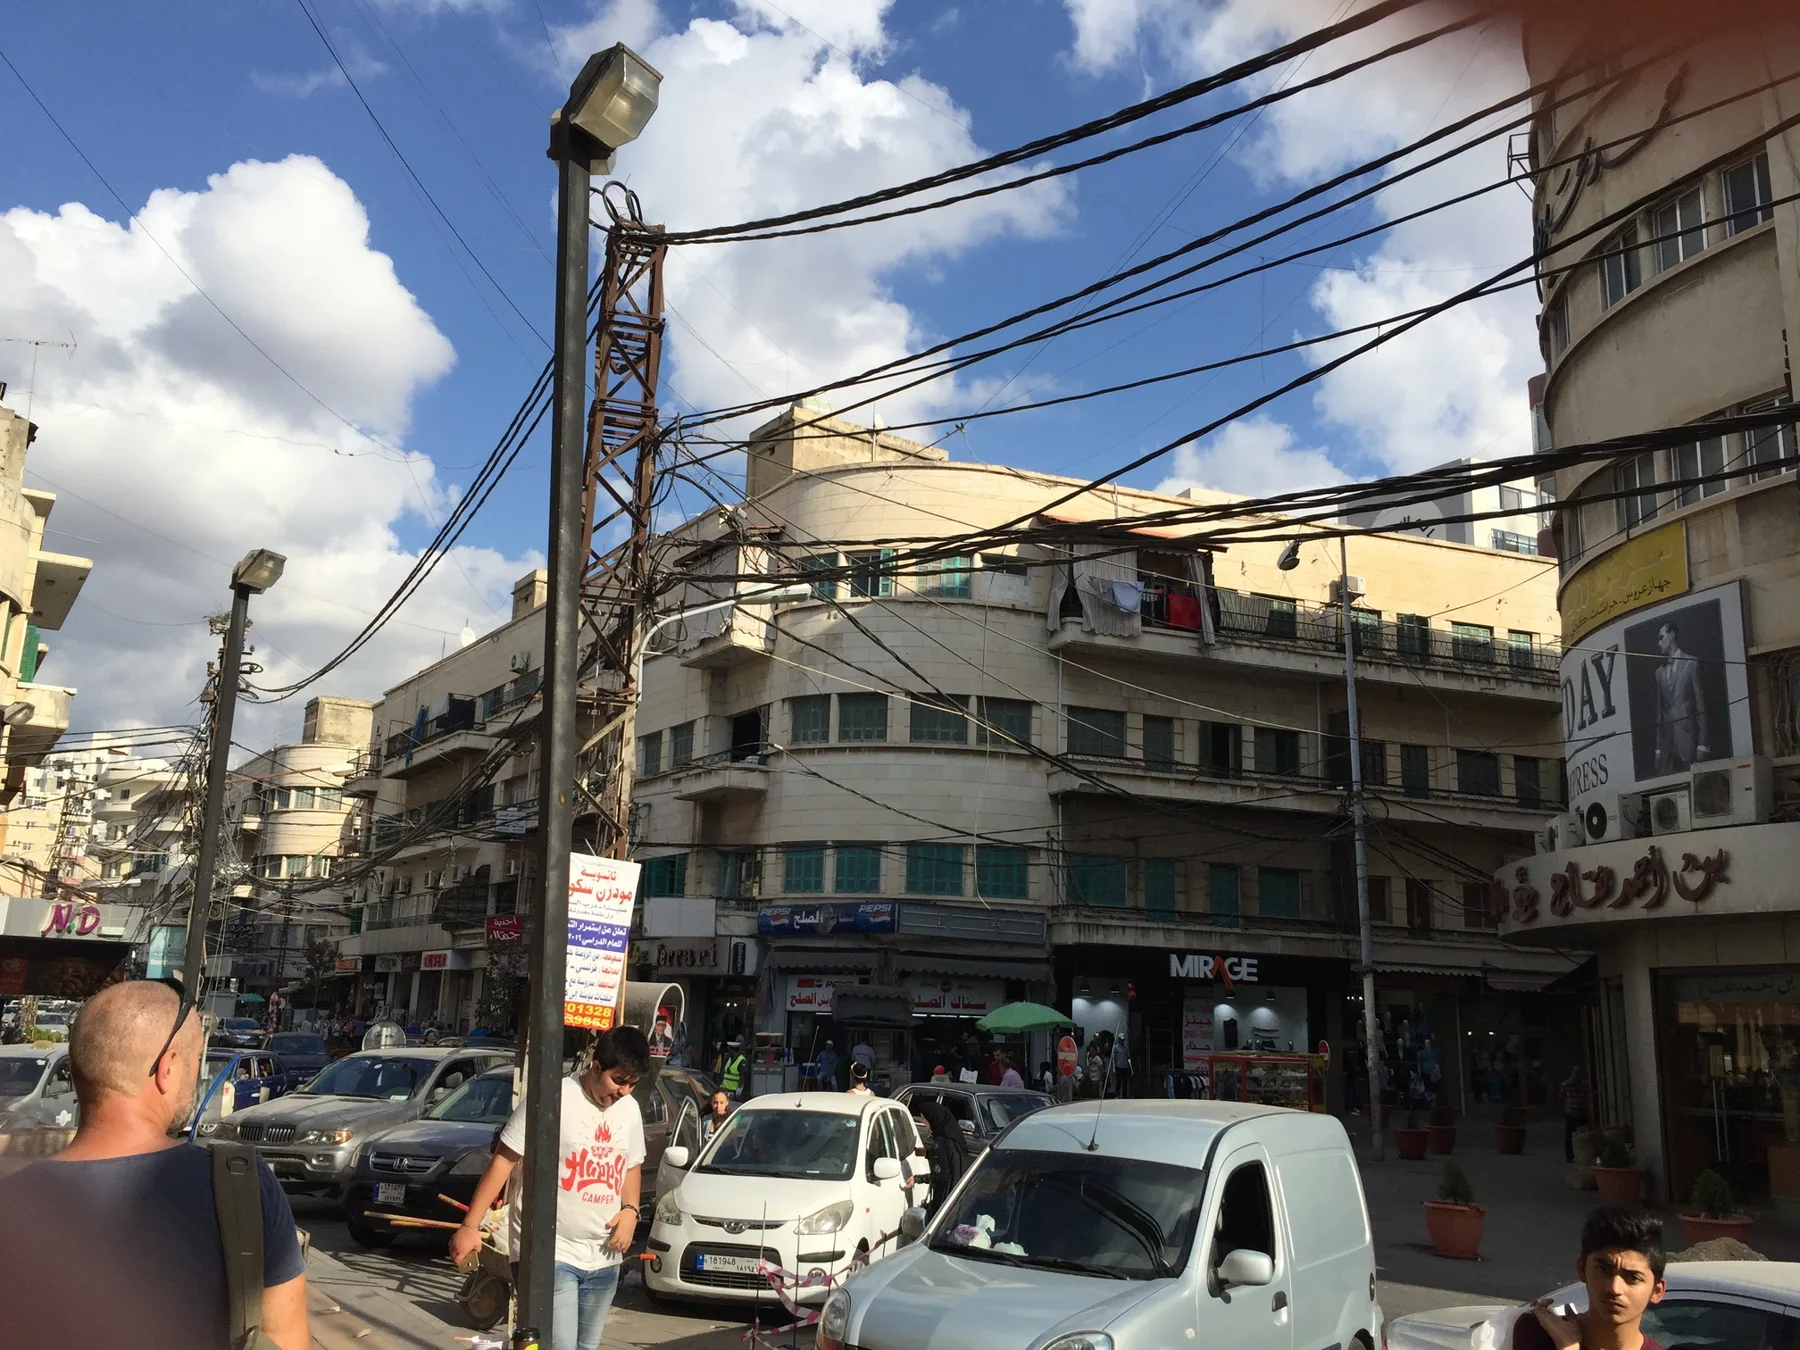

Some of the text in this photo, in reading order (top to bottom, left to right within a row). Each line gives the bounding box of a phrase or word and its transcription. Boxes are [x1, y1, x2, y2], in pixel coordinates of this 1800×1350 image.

[580, 866, 618, 882] ثانوية
[596, 887, 633, 904] مودرن
[760, 907, 792, 916] PEPSI
[858, 903, 892, 912] PEPSI
[793, 910, 823, 929] الصلح
[601, 926, 612, 935] عن
[612, 926, 627, 937] تعلن
[581, 936, 607, 946] الدراسي
[606, 939, 623, 948] للعام
[1169, 953, 1259, 990] MIRAGE
[790, 991, 817, 1008] الصلح
[951, 995, 987, 1010] سناك
[561, 1148, 626, 1196] Happy
[581, 1191, 615, 1205] CAMPER
[710, 1256, 736, 1266] 181948
